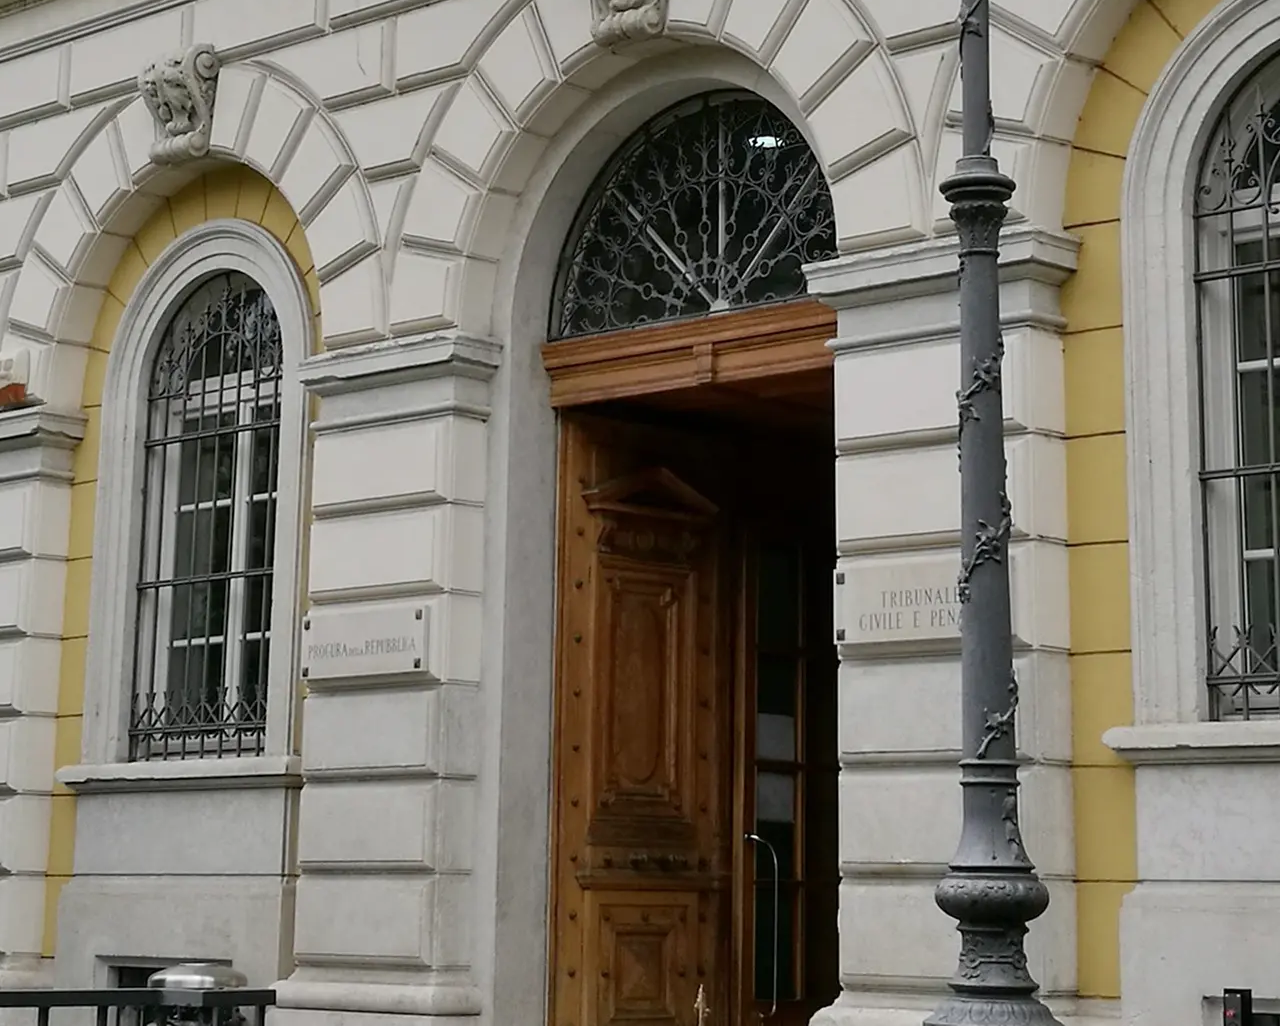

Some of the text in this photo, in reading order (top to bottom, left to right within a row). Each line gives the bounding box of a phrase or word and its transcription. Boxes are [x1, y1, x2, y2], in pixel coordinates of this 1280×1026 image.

[859, 611, 903, 631] CIVILE
[913, 610, 920, 629] E
[308, 643, 348, 660] PROCURA
[365, 636, 416, 655] REPUBBLICA
